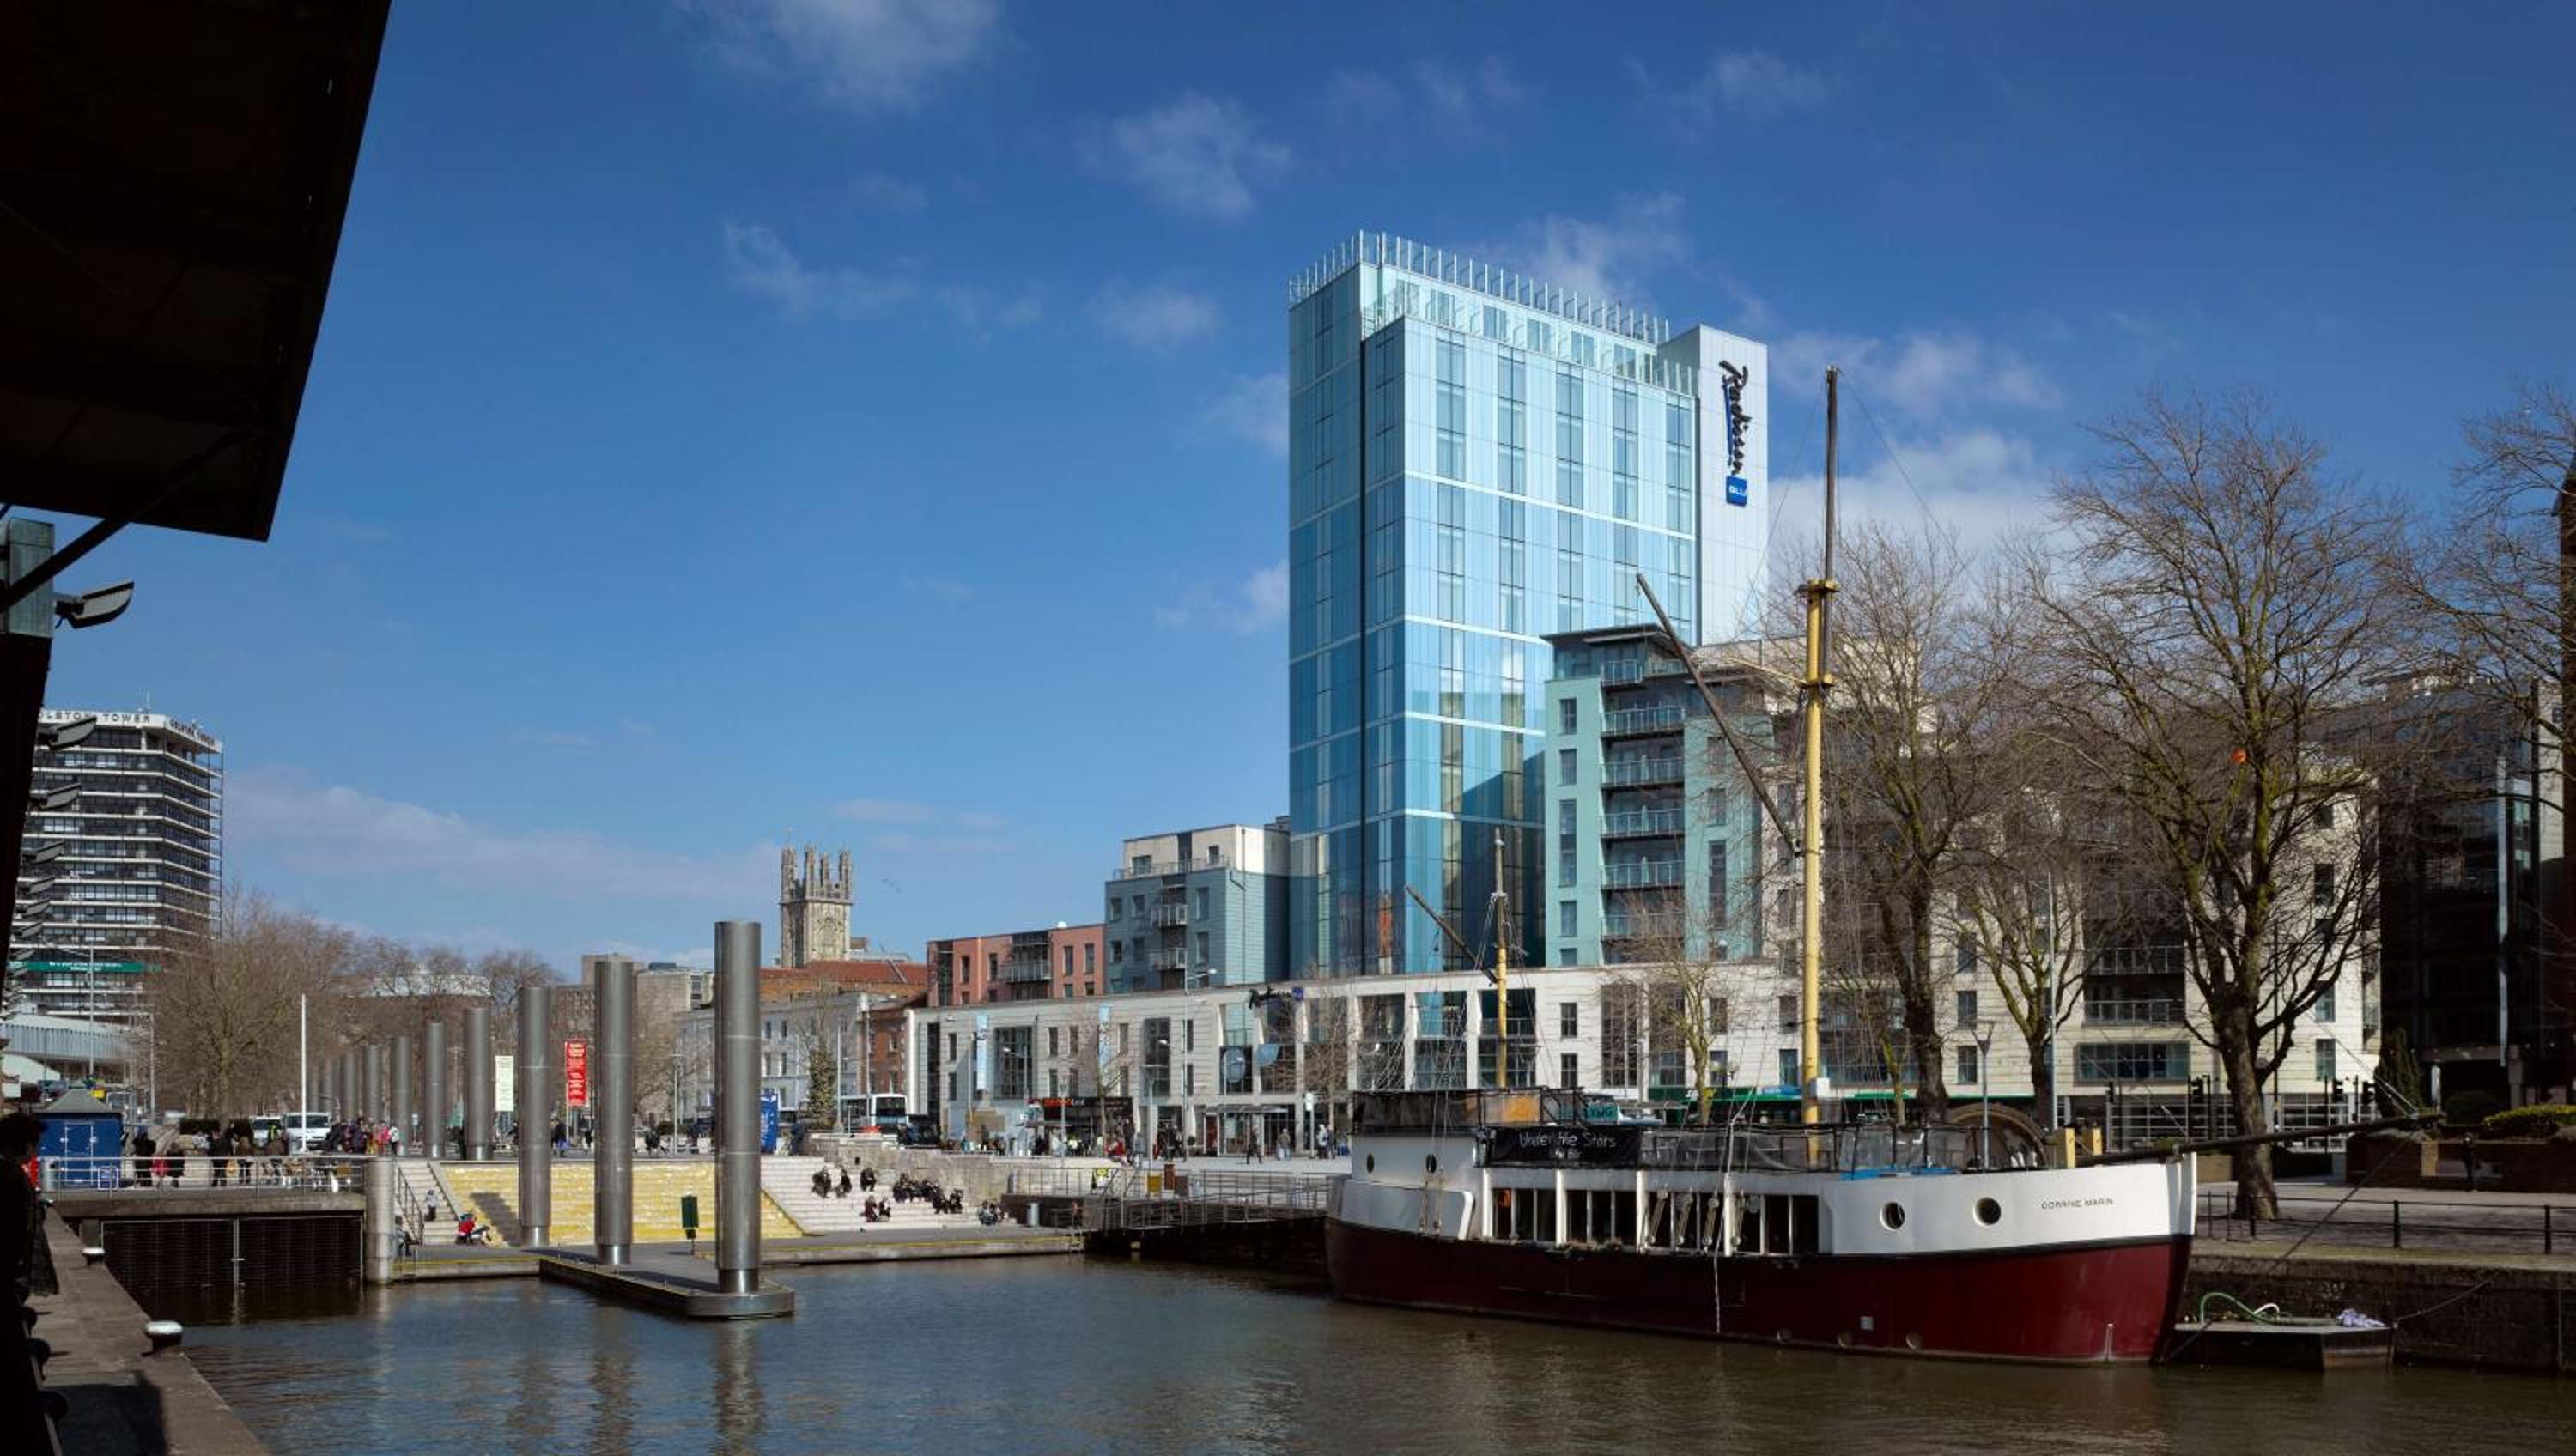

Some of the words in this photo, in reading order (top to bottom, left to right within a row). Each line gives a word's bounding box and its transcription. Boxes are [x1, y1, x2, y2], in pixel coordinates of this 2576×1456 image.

[103, 713, 151, 724] TOWER
[1519, 1131, 1552, 1148] Under
[1583, 1131, 1617, 1148] Stars
